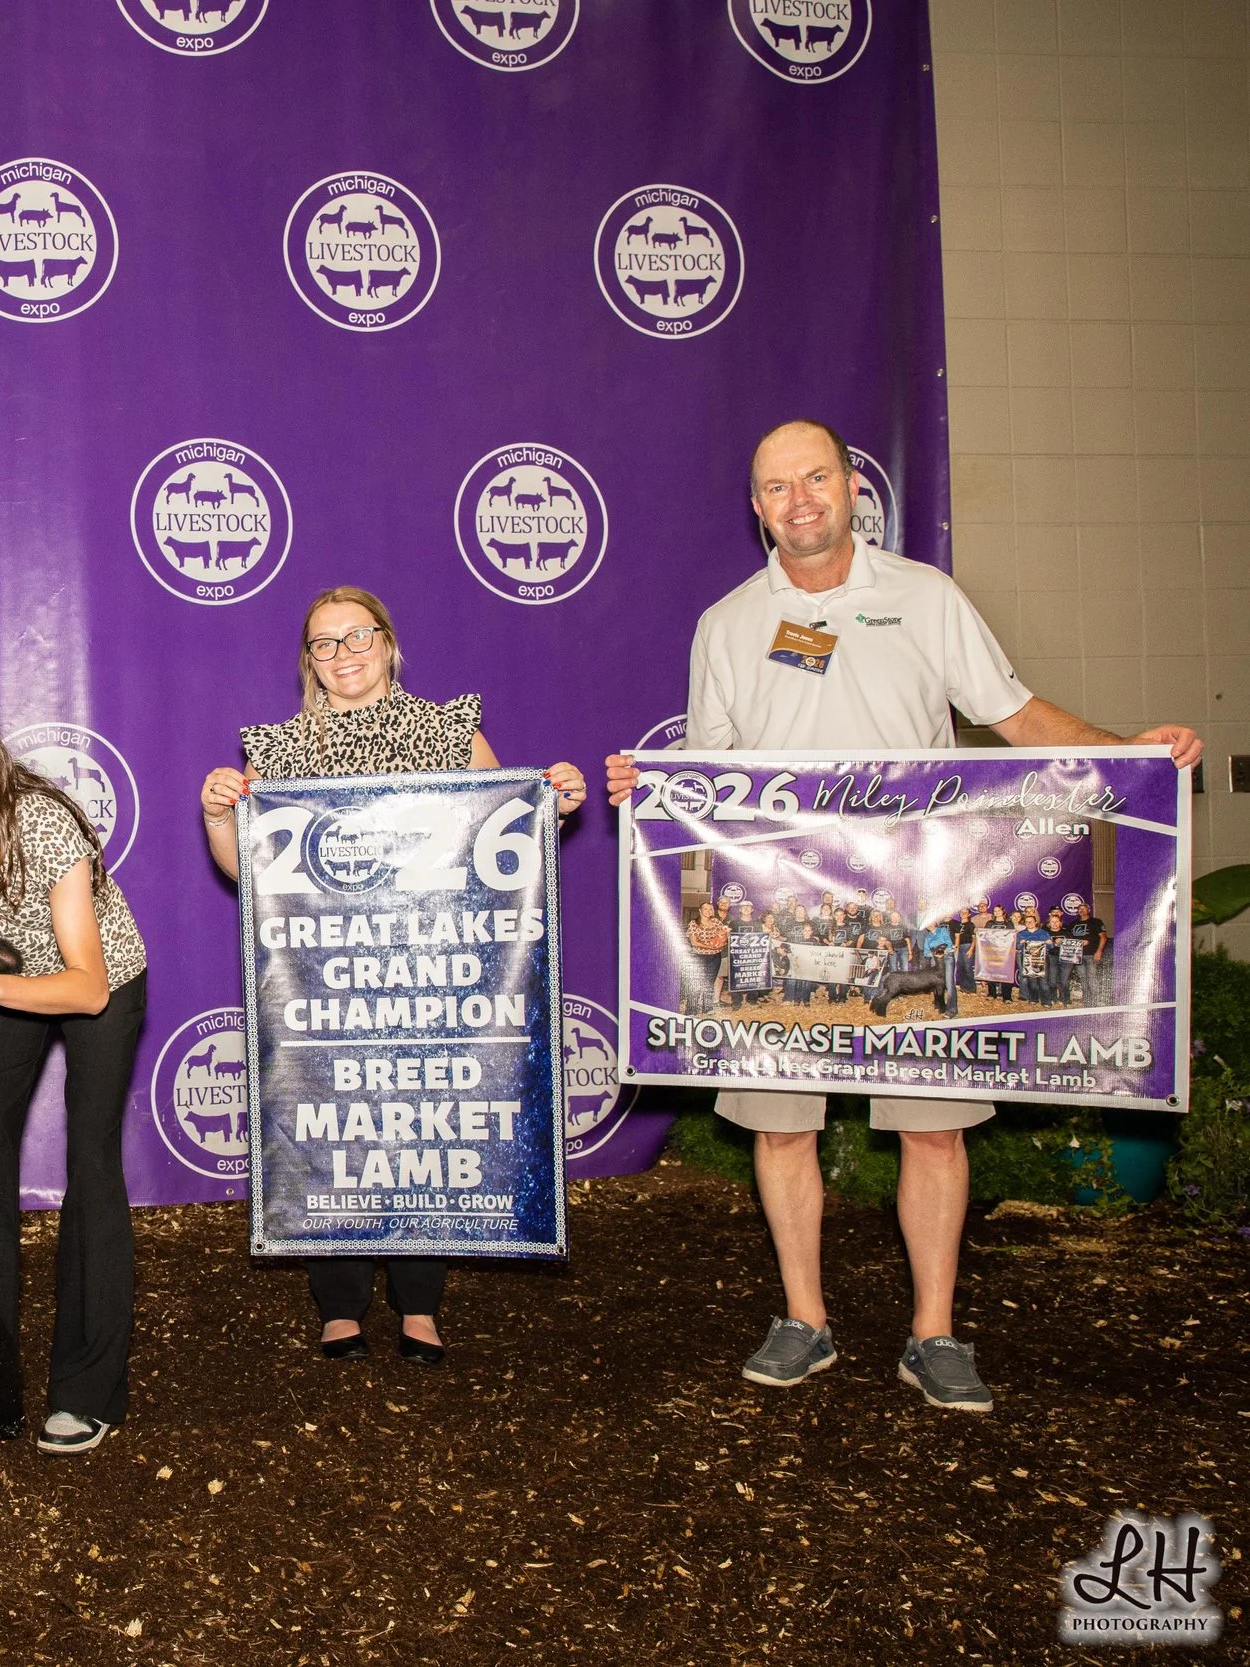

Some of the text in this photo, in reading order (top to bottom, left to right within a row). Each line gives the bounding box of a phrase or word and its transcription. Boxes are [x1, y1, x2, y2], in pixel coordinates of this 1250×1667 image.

[752, 0, 849, 20] LIVESTOCK
[177, 37, 213, 51] expo
[492, 52, 526, 67] expo
[789, 65, 821, 79] expo
[1, 163, 71, 184] michigan
[328, 176, 395, 197] michigan
[635, 189, 698, 208] michigan
[309, 242, 417, 262] LIVESTOCK
[618, 253, 722, 271] LIVESTOCK
[21, 303, 59, 318] expo
[349, 313, 385, 327] expo
[657, 321, 692, 334] expo
[176, 443, 245, 464] michigan
[497, 448, 562, 468] michigan
[156, 513, 267, 532] LIVESTOCK
[479, 516, 584, 533] LIVESTOCK
[197, 586, 234, 600] expo
[518, 586, 554, 600] expo
[18, 728, 91, 750] michigan
[813, 774, 919, 828] Miley
[923, 771, 1127, 816] Poindexter
[1016, 817, 1090, 836] Allen
[342, 884, 364, 893] expo
[260, 908, 544, 949] GREAT LAKES
[323, 953, 482, 990] GRAND
[283, 993, 526, 1031] CHAMPION
[196, 1012, 245, 1035] michig
[647, 1018, 1153, 1069] SHOWCASE MARKET LAMB
[333, 1057, 482, 1091] BREED
[692, 1053, 1096, 1088] Great Lakes Grand Breed Market Lamb
[176, 1085, 246, 1107] LIVEST
[295, 1100, 521, 1142] MARKET
[332, 1149, 483, 1189] LAMB
[307, 1194, 514, 1210] BELIEVE BUILD GROW
[302, 1218, 519, 1230] OUR YOUTH, OUR AGRICULTURE
